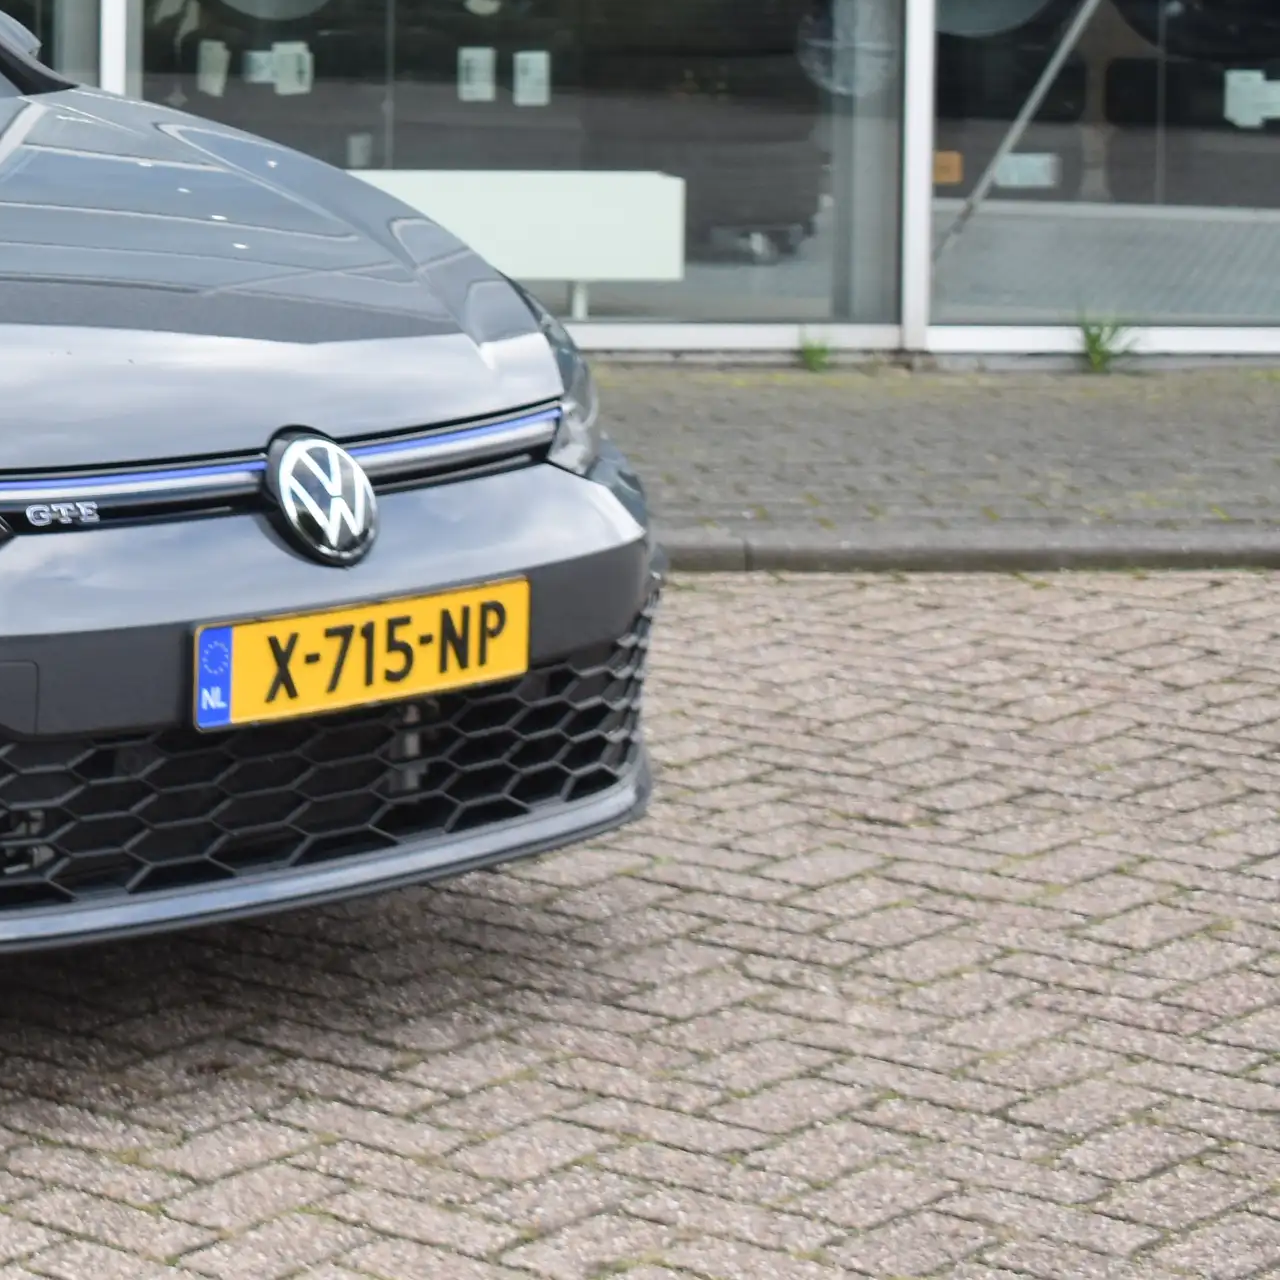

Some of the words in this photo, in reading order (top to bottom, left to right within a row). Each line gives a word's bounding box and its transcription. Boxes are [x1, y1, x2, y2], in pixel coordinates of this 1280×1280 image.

[25, 501, 100, 527] GTE
[265, 600, 507, 703] X-715-NP
[201, 685, 227, 711] NL
